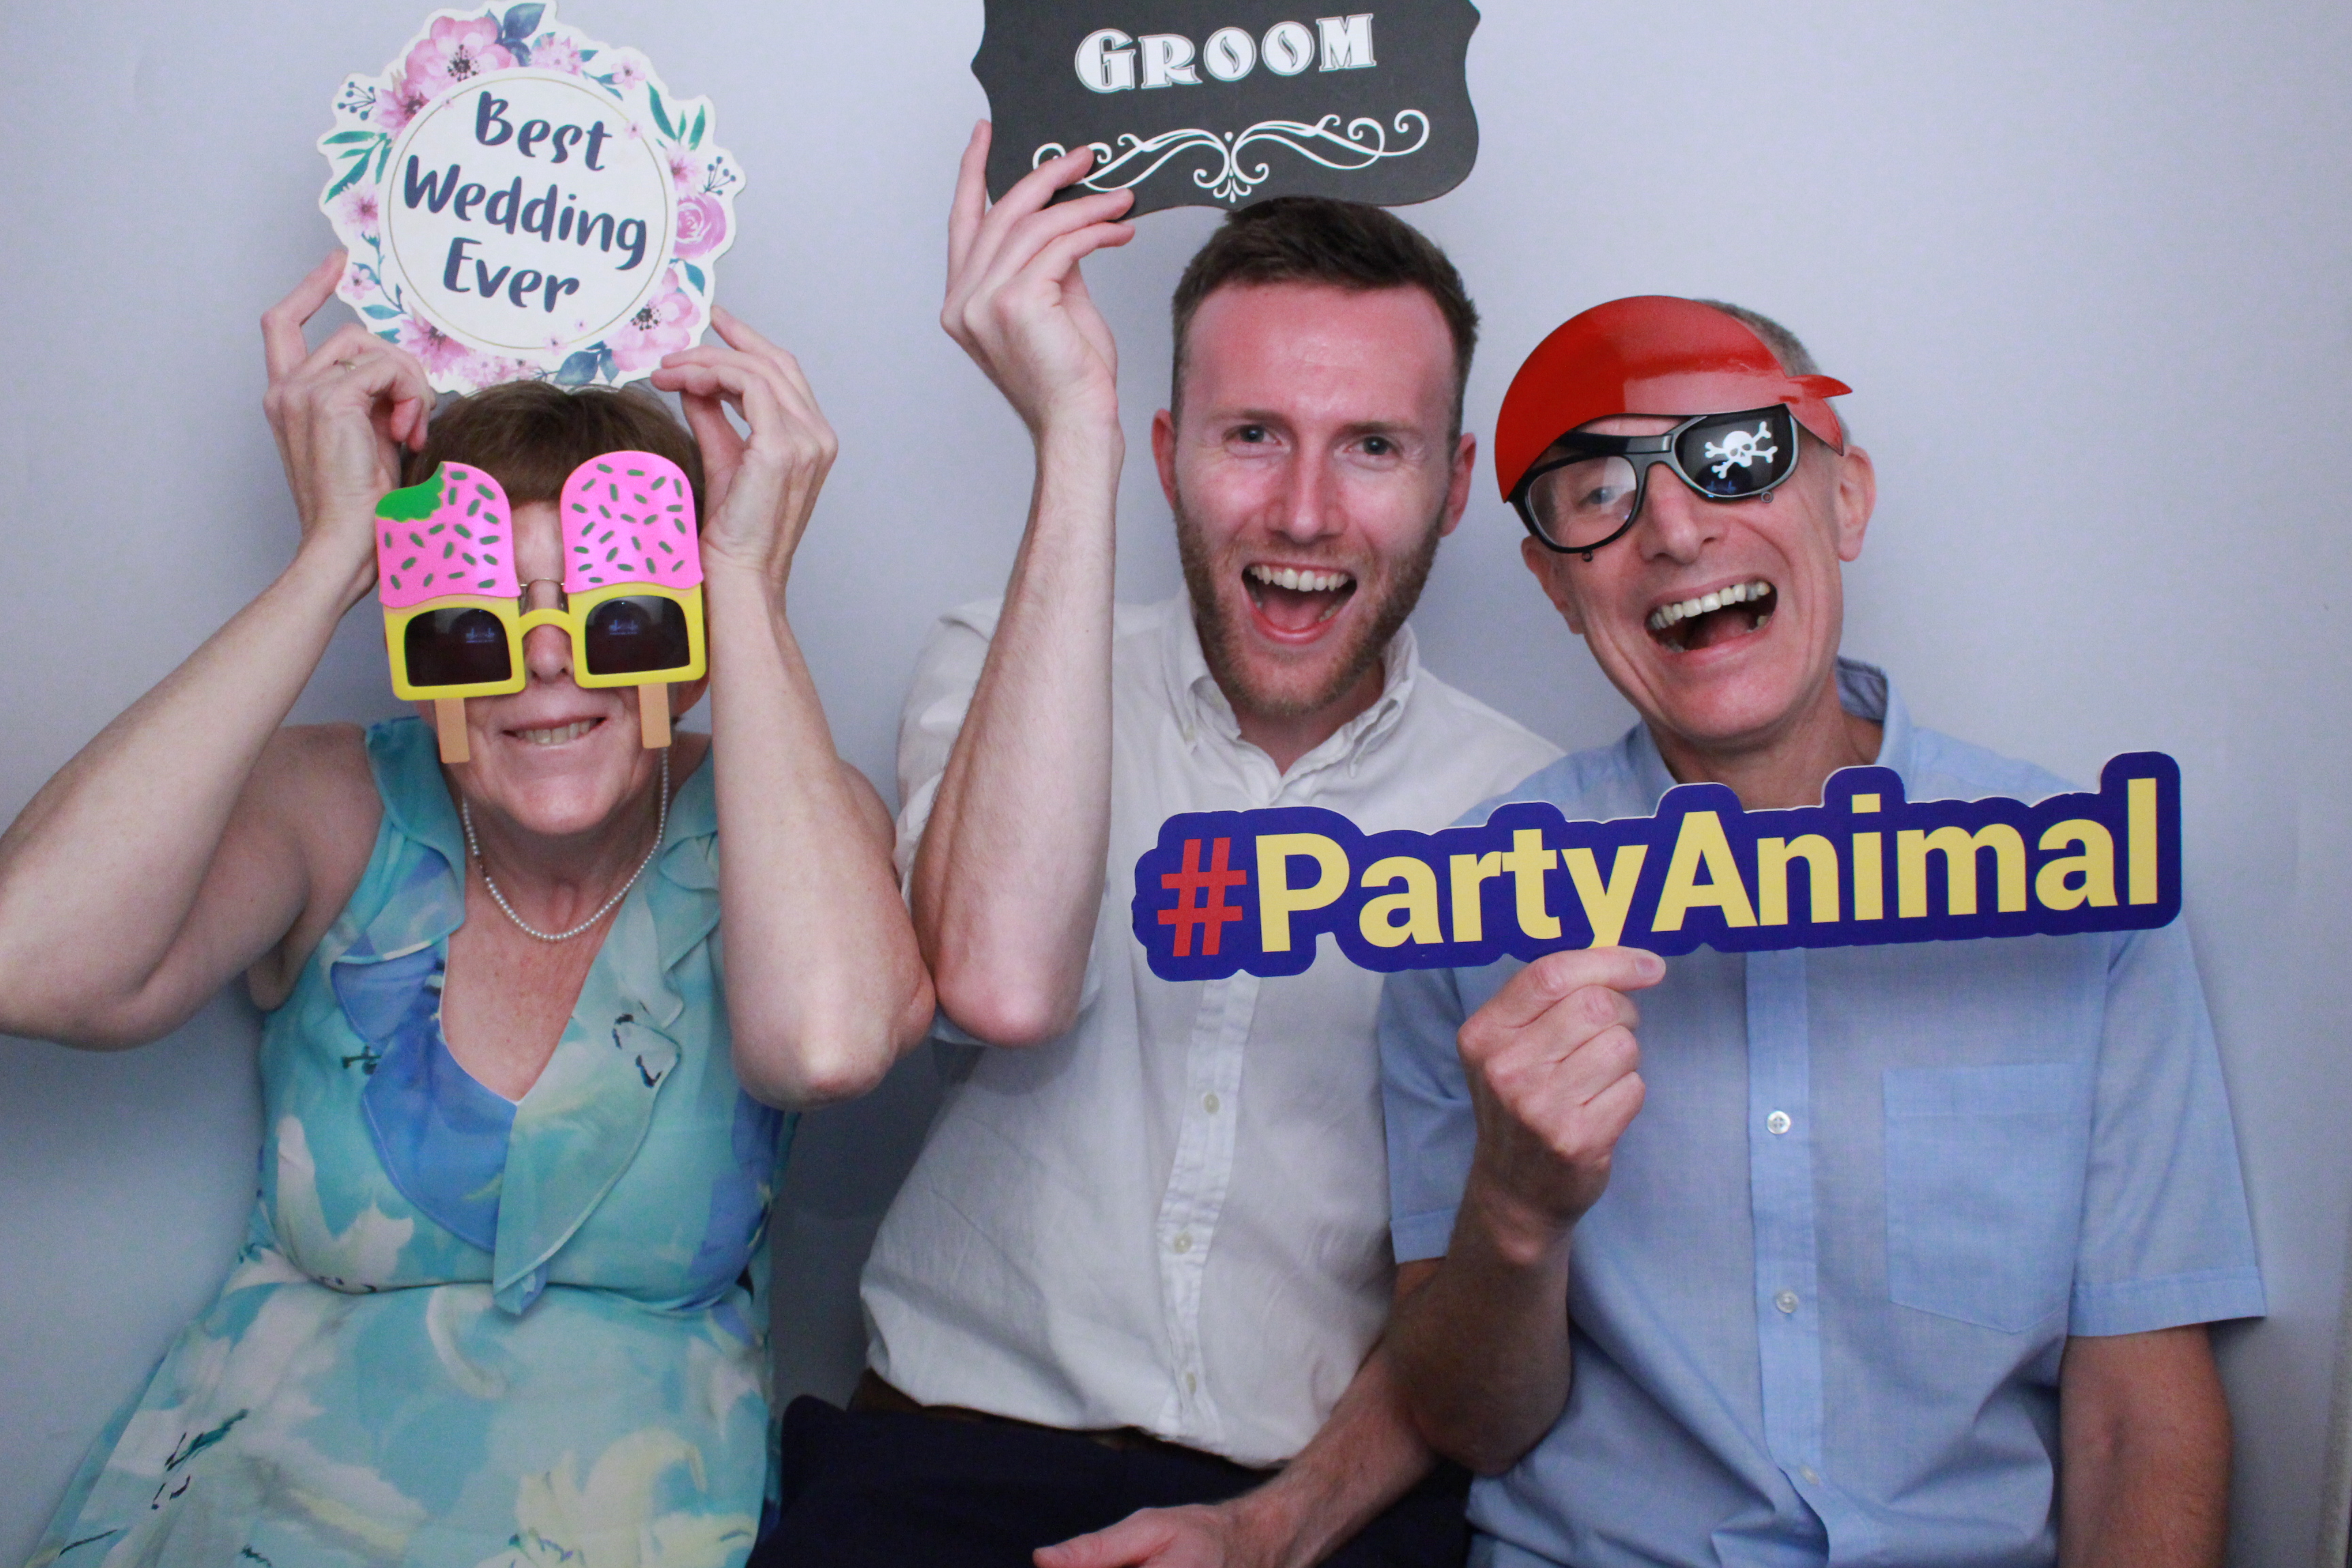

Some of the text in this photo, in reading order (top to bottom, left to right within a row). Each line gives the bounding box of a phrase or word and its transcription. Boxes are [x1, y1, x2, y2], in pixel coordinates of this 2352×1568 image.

[1074, 13, 1377, 93] GROOM
[475, 91, 612, 172] Best
[404, 155, 647, 271] Wedding
[443, 237, 580, 313] Ever
[1157, 777, 2158, 957] #PartyAnimal
